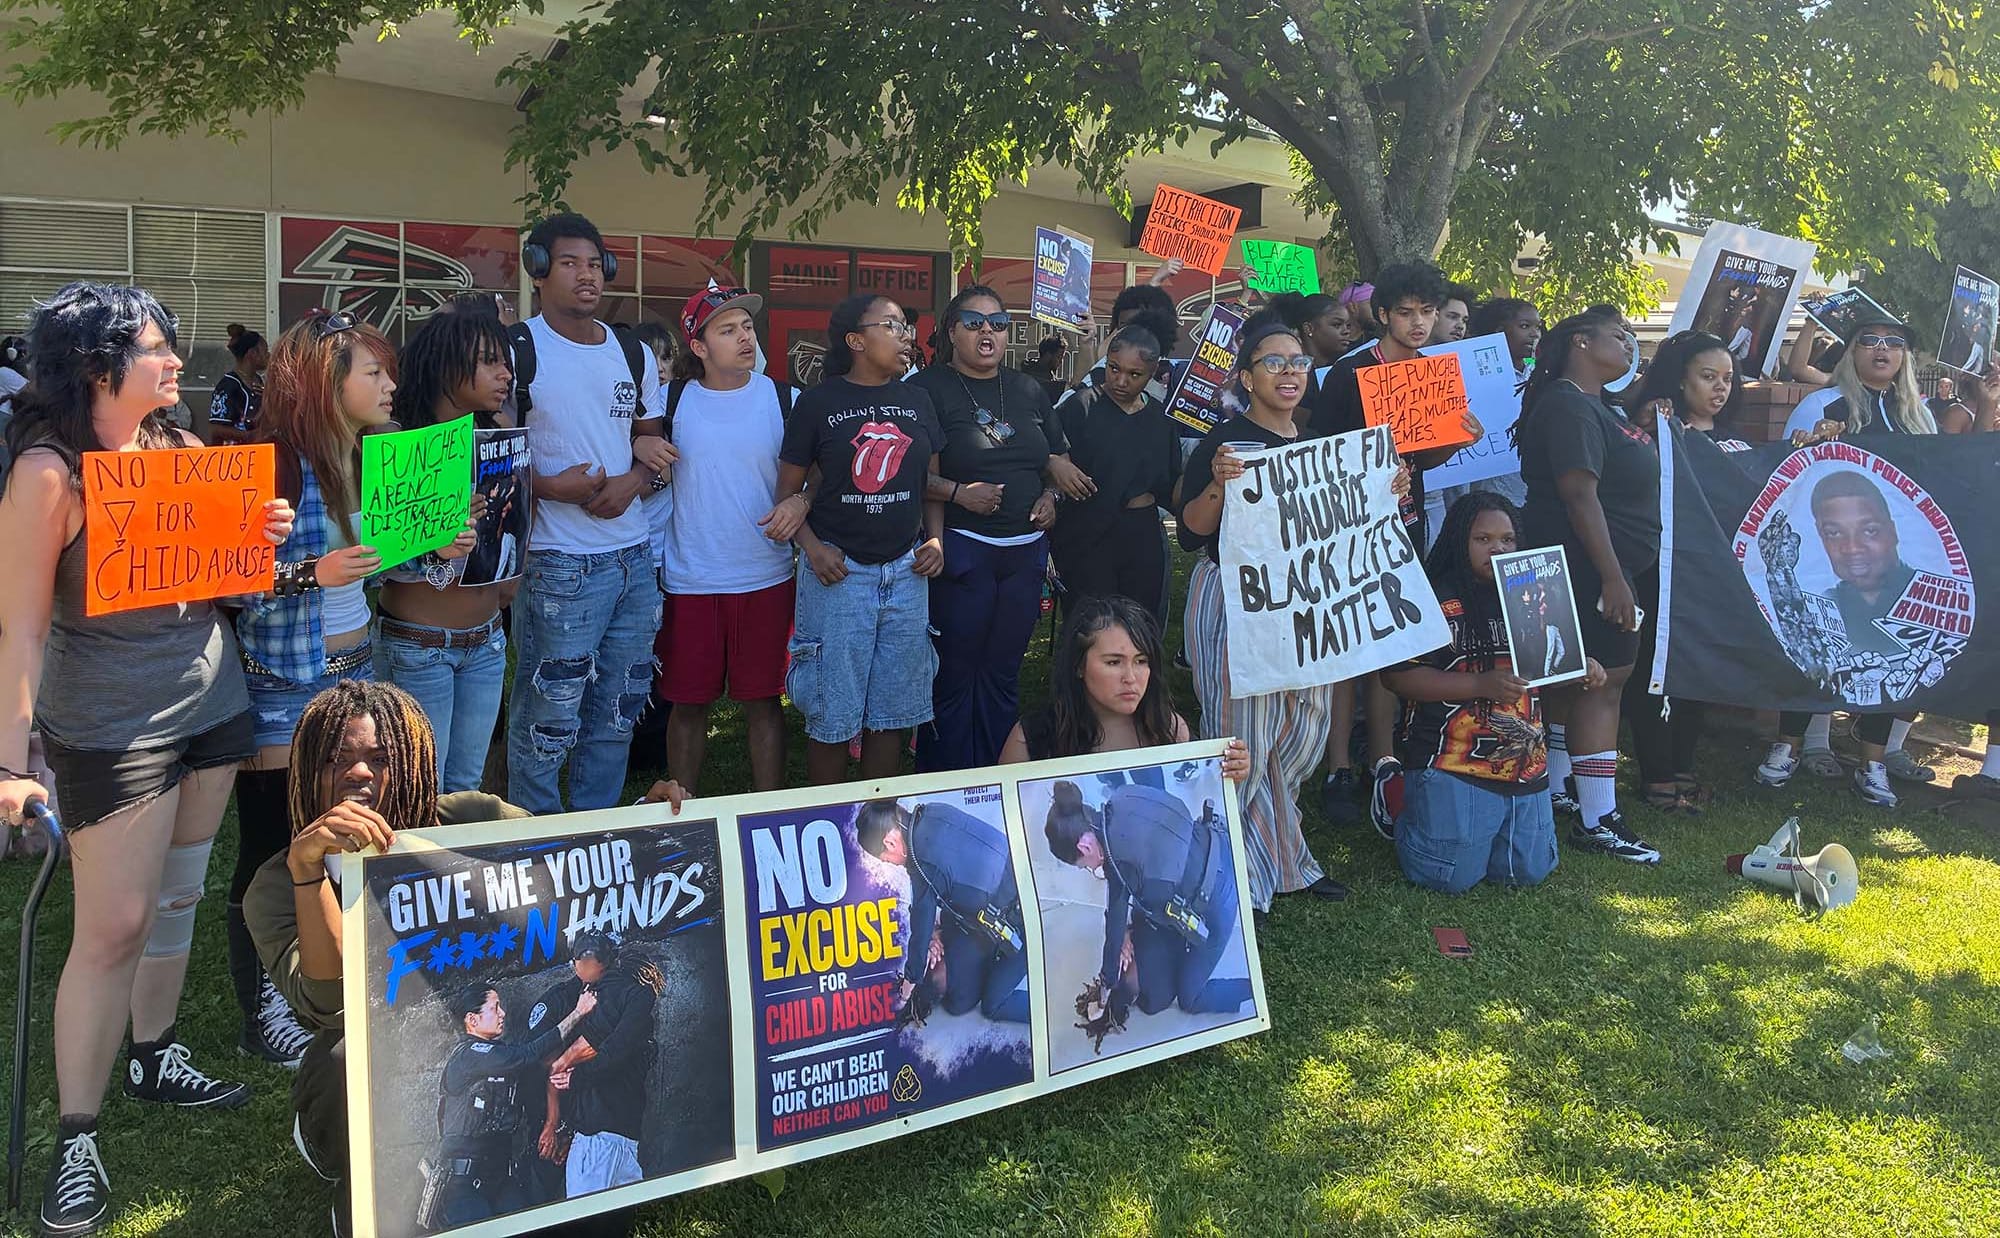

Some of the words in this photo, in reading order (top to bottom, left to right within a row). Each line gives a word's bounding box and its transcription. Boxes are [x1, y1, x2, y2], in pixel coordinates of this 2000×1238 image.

[1039, 237, 1058, 260] NO
[1246, 241, 1304, 264] BLACK
[783, 263, 838, 286] MAIN
[859, 268, 929, 291] OFFICE
[1037, 255, 1067, 276] EXCUSE
[1725, 256, 1745, 270] GIVE
[1744, 259, 1758, 272] ME
[1759, 261, 1778, 275] YOUR
[1757, 273, 1789, 289] HANDS
[1206, 318, 1233, 348] NO
[1199, 340, 1236, 371] EXCUSE
[1363, 364, 1407, 399] SHE
[1405, 358, 1460, 387] PUNCHED
[1373, 392, 1407, 420] HIM
[1411, 384, 1429, 405] IN
[1430, 380, 1455, 398] THE
[1425, 395, 1467, 422] MULTIPLE
[828, 406, 876, 428] ROLLING
[480, 441, 498, 461] GIVE
[499, 439, 509, 457] ME
[511, 435, 525, 454] YOUR
[1393, 424, 1437, 445] IMES.
[95, 457, 145, 490] NO
[174, 451, 256, 484] EXCUSE
[381, 423, 468, 486] PUNCHES
[1243, 438, 1346, 504] JUSTICE
[1361, 424, 1400, 472] FOR
[369, 483, 406, 510] ARE
[407, 469, 442, 500] NOT
[841, 494, 862, 504] NORTH
[863, 493, 895, 504] AMERICAN
[156, 502, 197, 532] FOR
[866, 504, 883, 514] 1975
[1278, 472, 1371, 551] MAURICE
[1872, 457, 1922, 501] POLICE
[1916, 496, 1969, 577] BRUTALITY
[96, 545, 200, 600] CHILD
[207, 547, 271, 583] ABUSE
[1239, 542, 1340, 612] BLACK
[1504, 561, 1520, 577] GIVE
[1520, 558, 1530, 571] ME
[1529, 554, 1546, 569] YOUR
[1535, 560, 1561, 580] HANDS
[1918, 573, 1958, 589] JUSTICE
[1907, 581, 1970, 612] MARIO
[1294, 572, 1421, 667] MATTER
[1892, 600, 1971, 634] ROMERO
[751, 819, 848, 914] NO
[388, 871, 475, 932] GIVE
[483, 858, 538, 913] ME
[544, 839, 636, 898] YOUR
[563, 862, 705, 948] HANDS
[759, 897, 902, 982] EXCUSE
[819, 972, 848, 993] FOR
[765, 996, 826, 1046] CHILD
[832, 982, 896, 1032] ABUSE
[772, 1069, 797, 1093] WE
[801, 1058, 845, 1086] CAN'T
[849, 1049, 885, 1076] BEAT
[772, 1090, 807, 1116] OUR
[812, 1070, 889, 1108] CHILDREN
[773, 1109, 830, 1137] NEITHER
[834, 1103, 860, 1122] CAN
[864, 1094, 888, 1115] YOU
